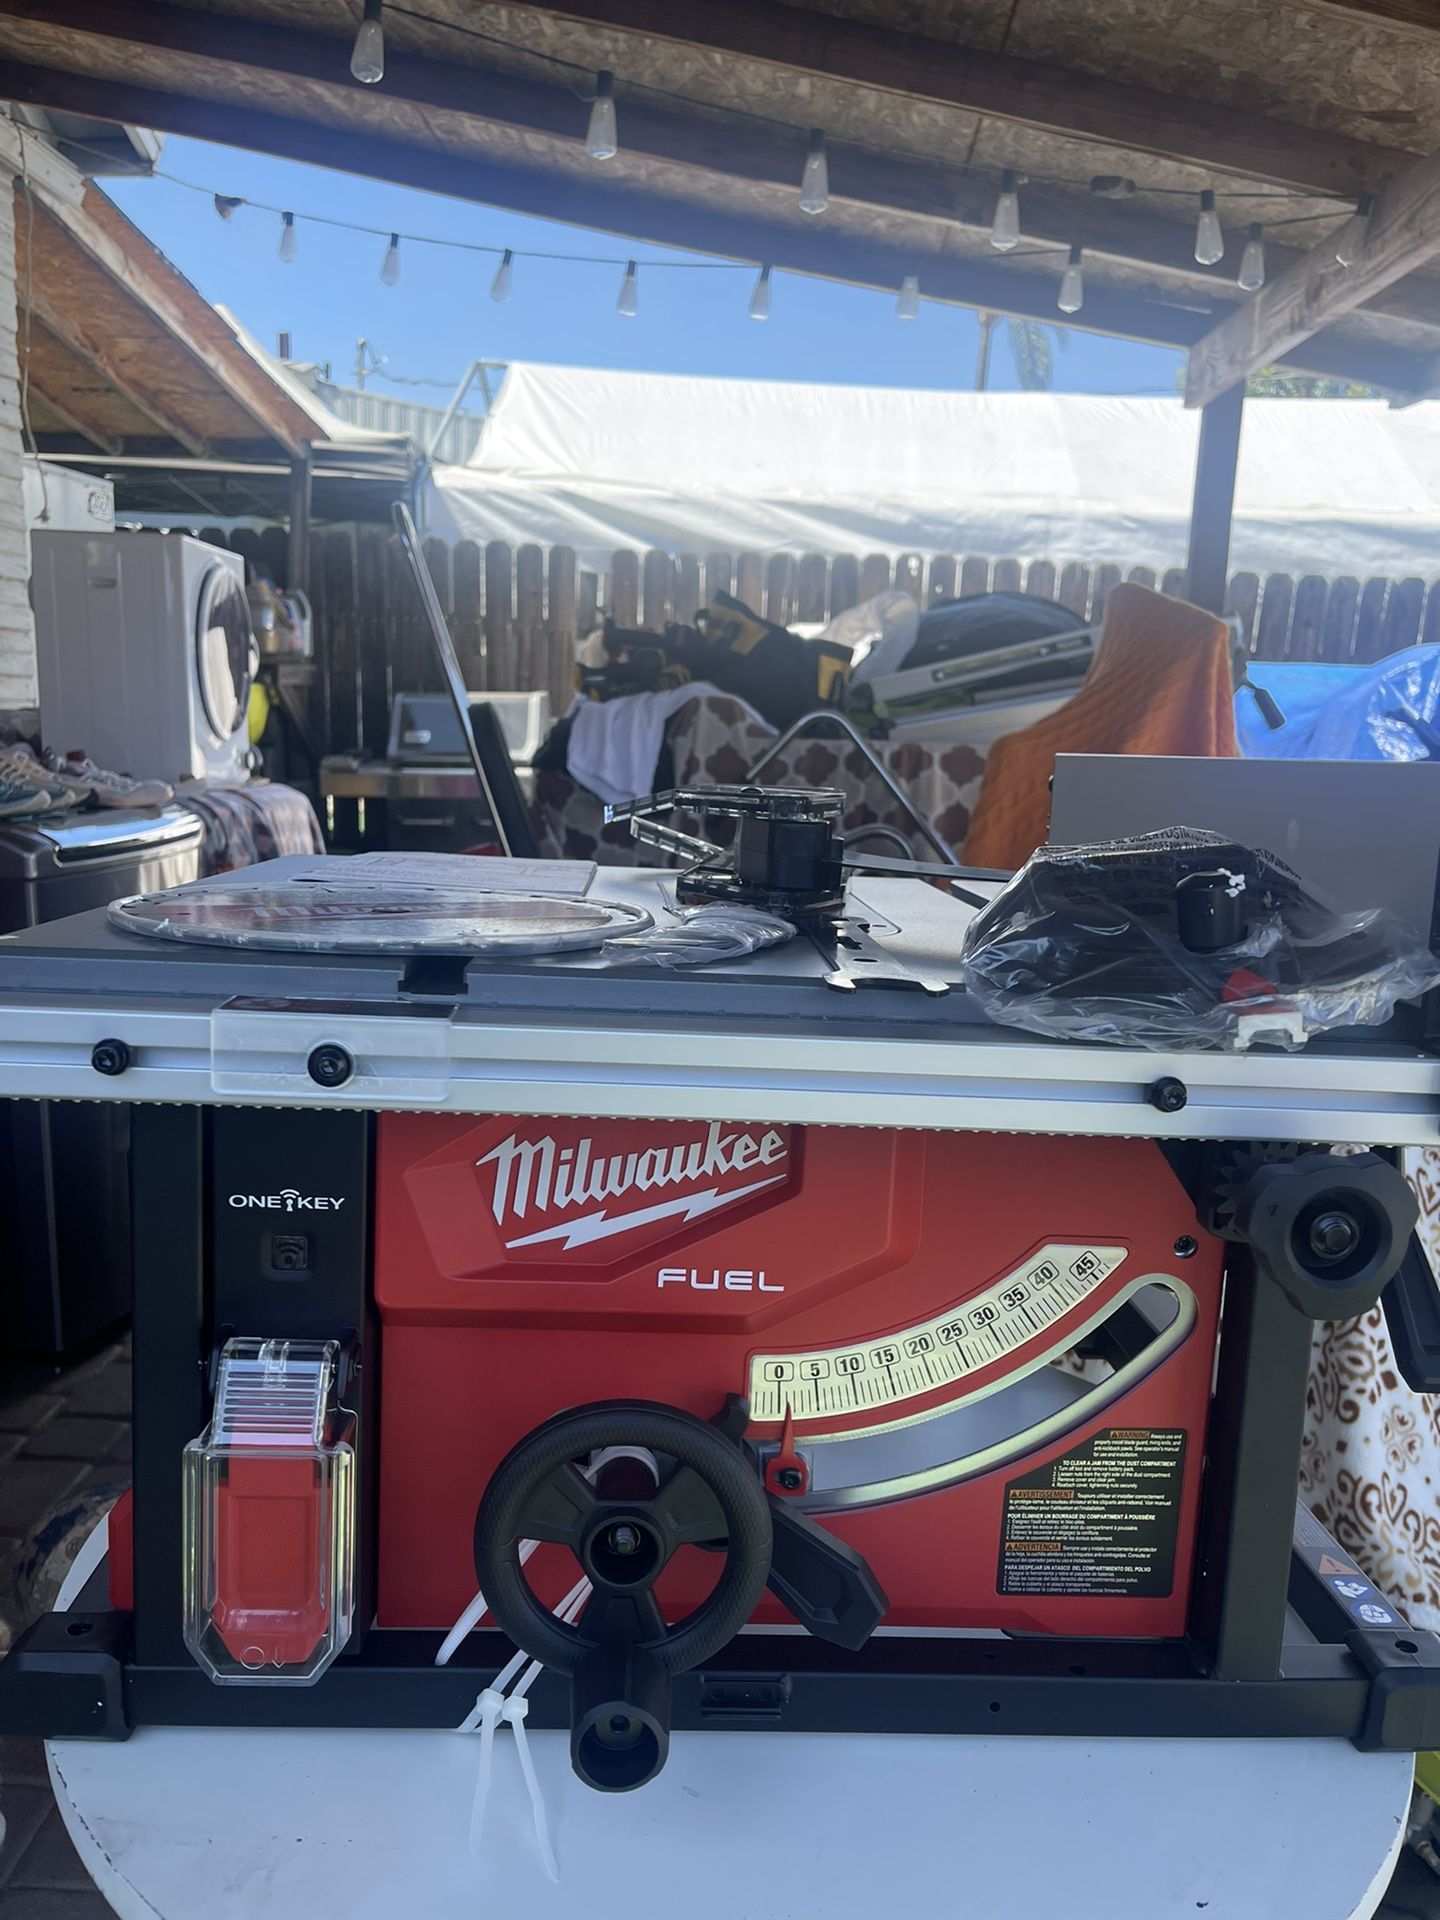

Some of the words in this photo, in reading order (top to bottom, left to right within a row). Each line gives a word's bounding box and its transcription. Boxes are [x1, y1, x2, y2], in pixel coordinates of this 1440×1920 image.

[475, 1121, 788, 1226] Milwaukee
[657, 1268, 785, 1292] FUEL
[774, 1364, 785, 1379] 0
[810, 1363, 821, 1377] 5
[840, 1357, 860, 1373] 10
[874, 1349, 895, 1365] 15
[908, 1337, 930, 1355] 20
[941, 1323, 962, 1342] 25
[973, 1306, 995, 1325] 30
[1003, 1287, 1024, 1307] 35
[1033, 1266, 1054, 1286] 40
[1074, 1256, 1095, 1277] 45
